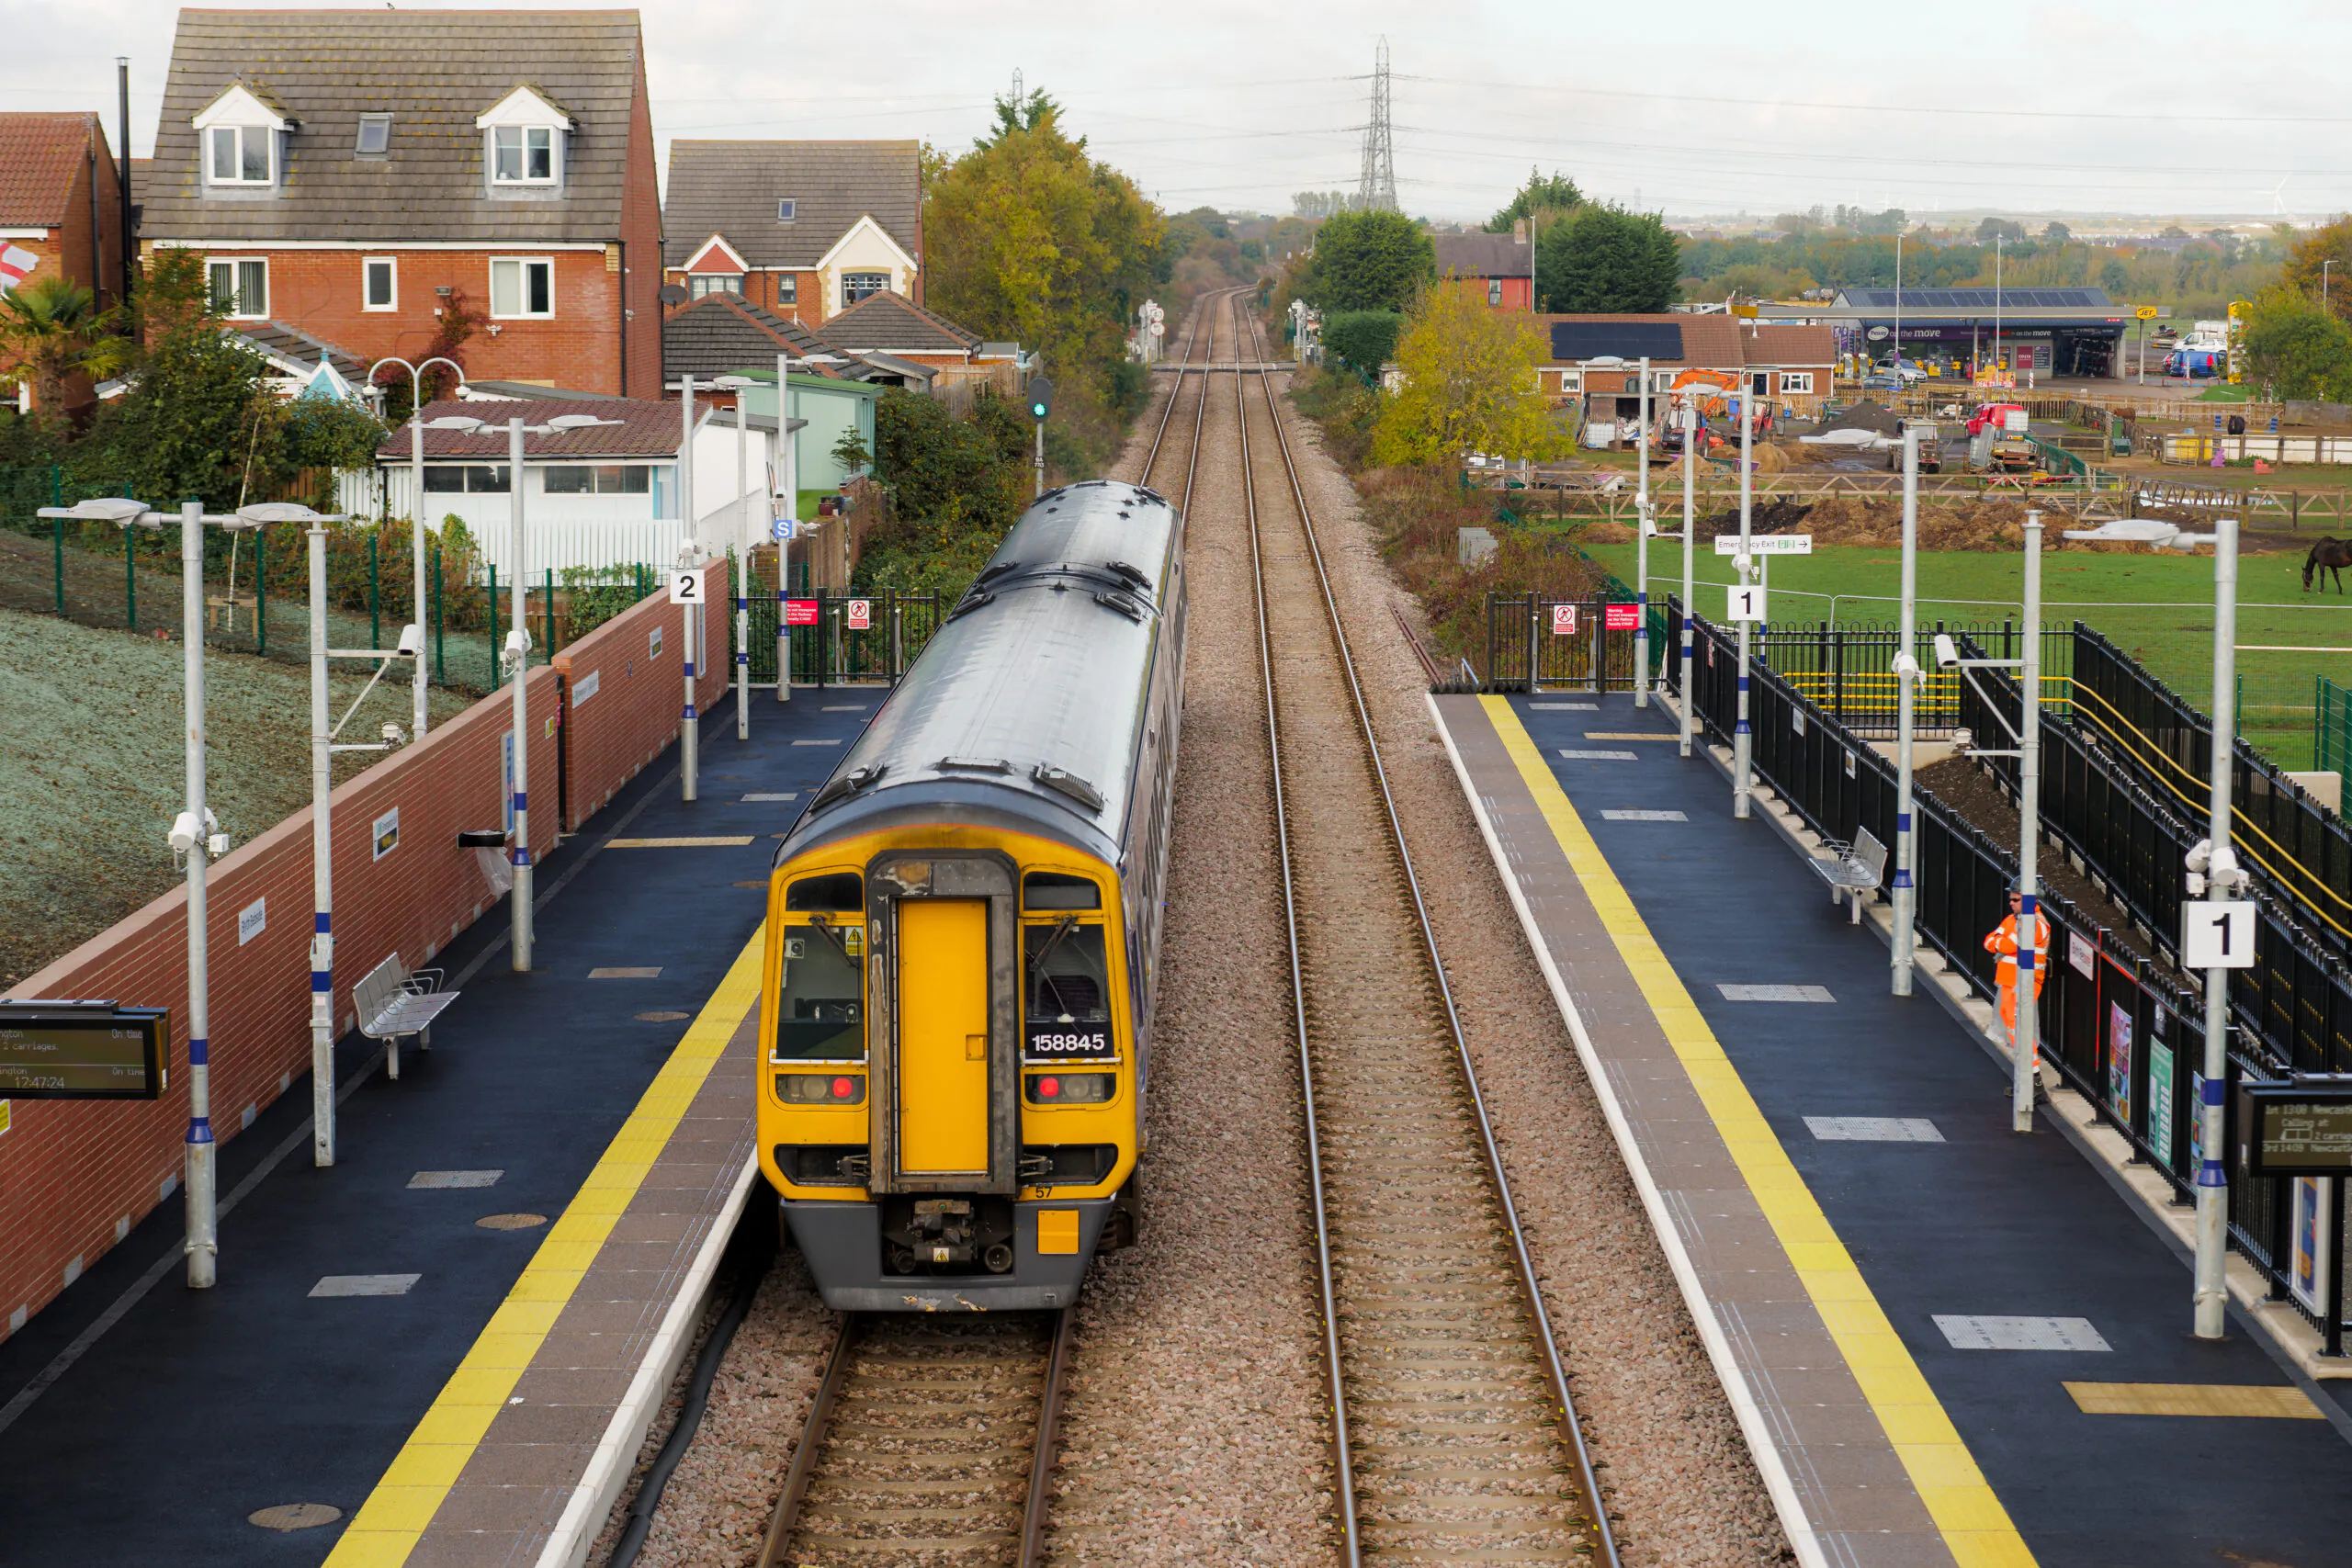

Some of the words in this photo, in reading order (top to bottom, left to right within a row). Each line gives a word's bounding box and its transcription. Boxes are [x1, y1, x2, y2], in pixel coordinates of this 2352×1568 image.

[1900, 329, 1913, 337] the
[1914, 329, 1941, 337] move
[777, 521, 789, 536] S
[1718, 540, 1760, 549] Emergcy
[680, 575, 695, 598] 2
[1740, 592, 1751, 615] 1
[2211, 912, 2231, 956] 1
[111, 1028, 123, 1039] On
[126, 1029, 143, 1039] time
[3, 1042, 8, 1051] 2
[12, 1041, 59, 1053] carriages.
[1032, 1033, 1105, 1052] 158845
[111, 1066, 123, 1076] On
[127, 1067, 145, 1077] time
[15, 1077, 65, 1089] 12:47:24
[2281, 1118, 2314, 1129] Calling
[1035, 1187, 1053, 1199] 57
